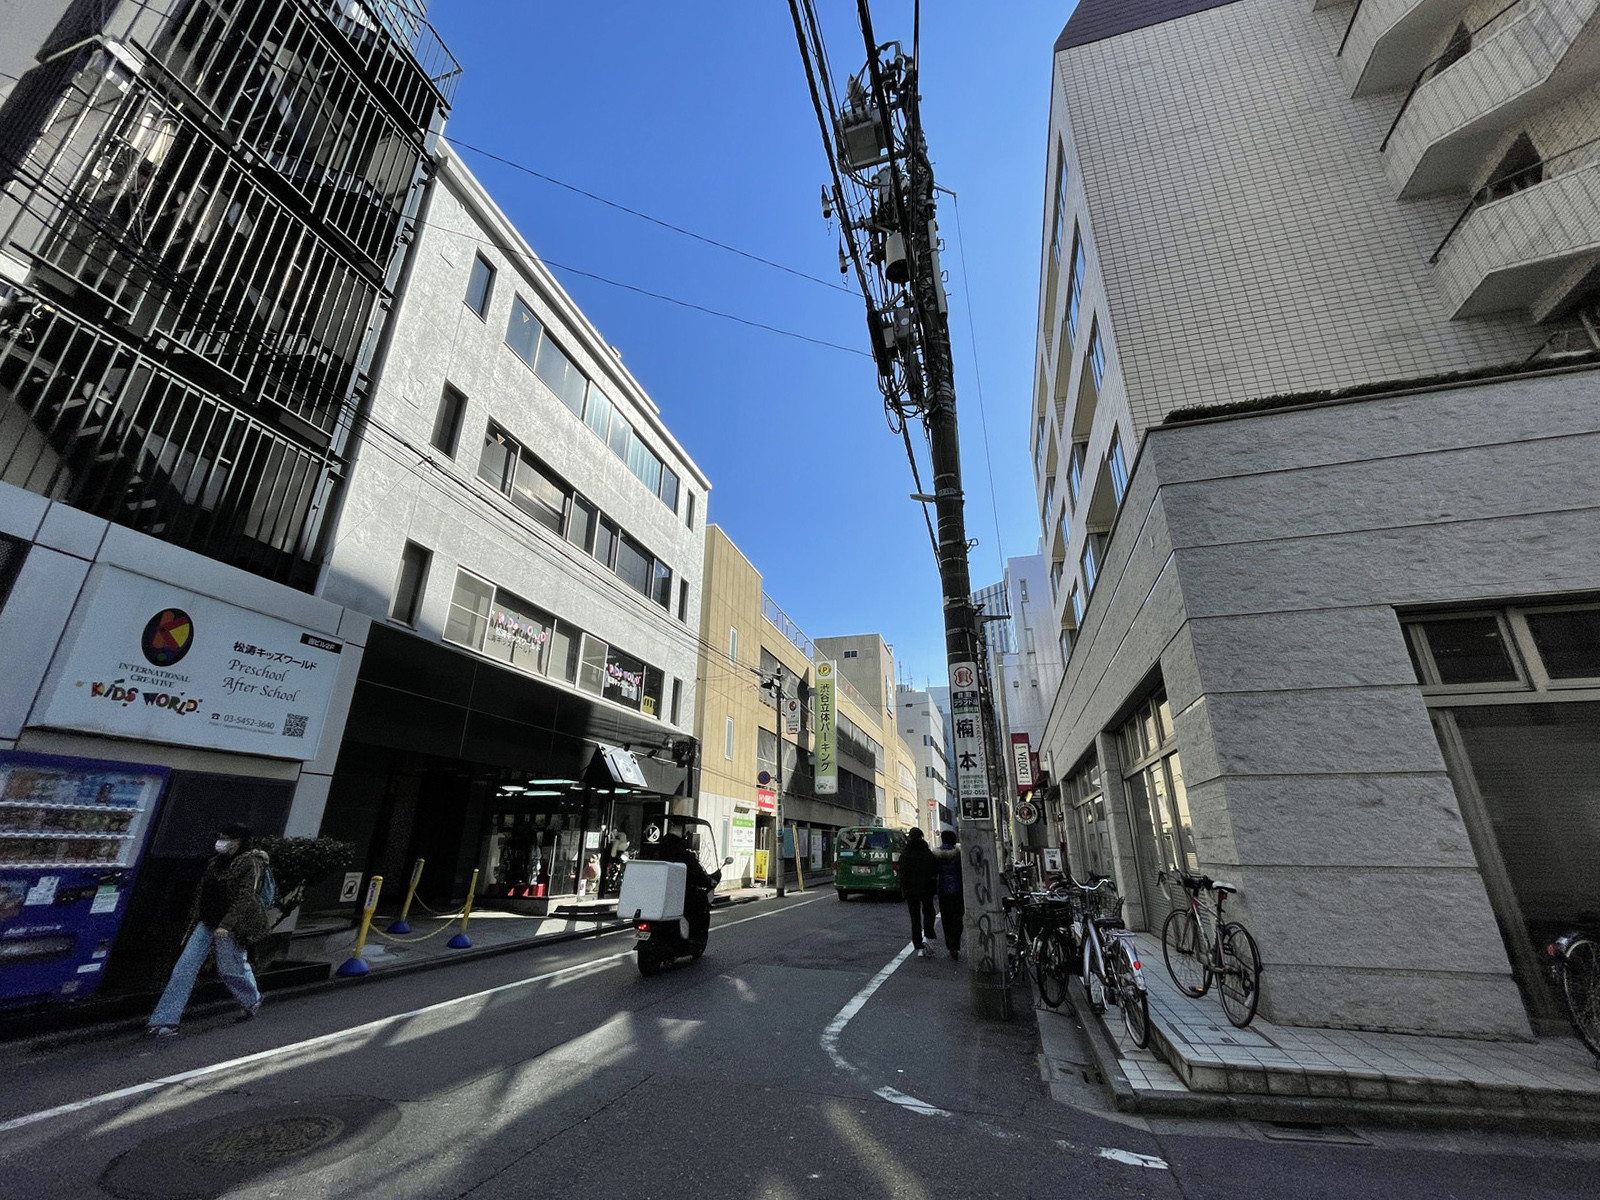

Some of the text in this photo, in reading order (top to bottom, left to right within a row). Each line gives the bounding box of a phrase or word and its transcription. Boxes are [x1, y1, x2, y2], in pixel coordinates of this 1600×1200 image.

[233, 640, 317, 671] 松濤キッズワールド
[118, 662, 190, 683] INTERNATIONAL
[130, 673, 175, 689] CREATIVE
[228, 659, 290, 682] Preschool
[222, 676, 301, 702] After School
[223, 714, 275, 730] 03-5452-3640
[820, 683, 830, 772] 渋谷立体パーキング
[956, 718, 977, 771] 楠本
[1017, 752, 1029, 776] VELOCE
